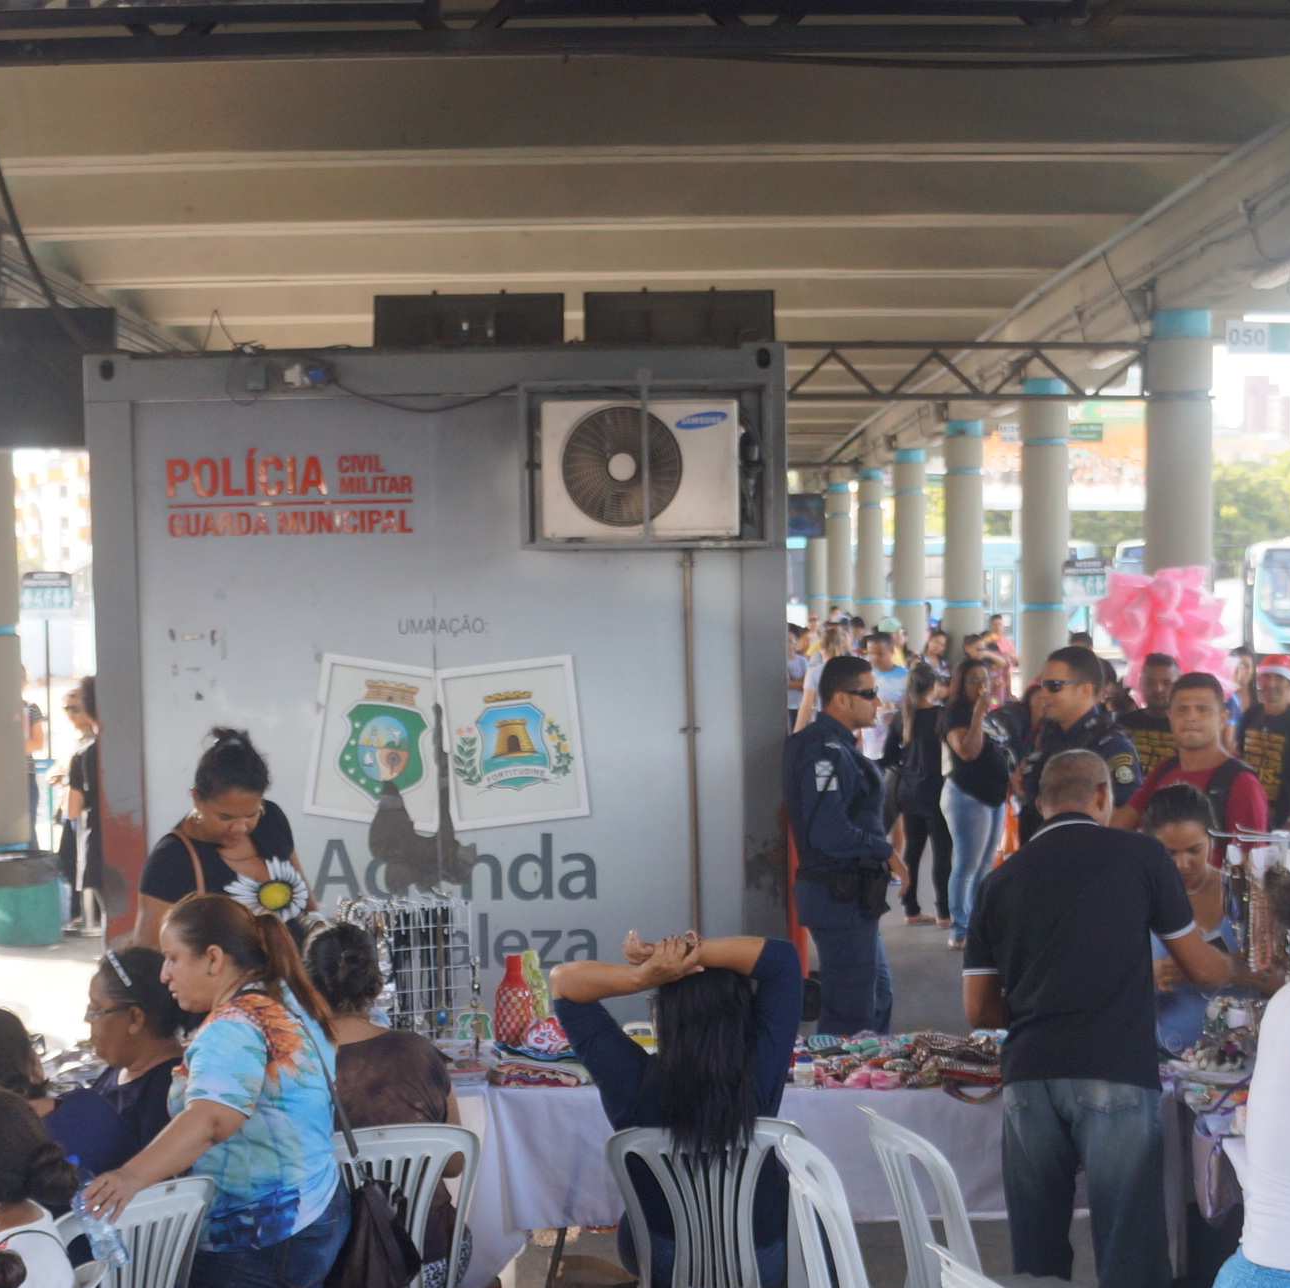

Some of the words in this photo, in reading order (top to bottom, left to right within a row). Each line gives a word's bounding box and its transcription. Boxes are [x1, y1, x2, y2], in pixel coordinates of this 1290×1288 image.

[1228, 328, 1265, 346] 050
[166, 448, 329, 498] POLÍCIA
[337, 454, 386, 474] CIVIL
[338, 475, 413, 495] MILITAR
[168, 511, 271, 538] GUARDA
[277, 509, 414, 535] MUNICIPAL
[398, 618, 433, 635] UMA
[437, 613, 490, 638] AÇÃO:
[486, 768, 547, 784] FORTITUDINE
[314, 832, 598, 901] Anda
